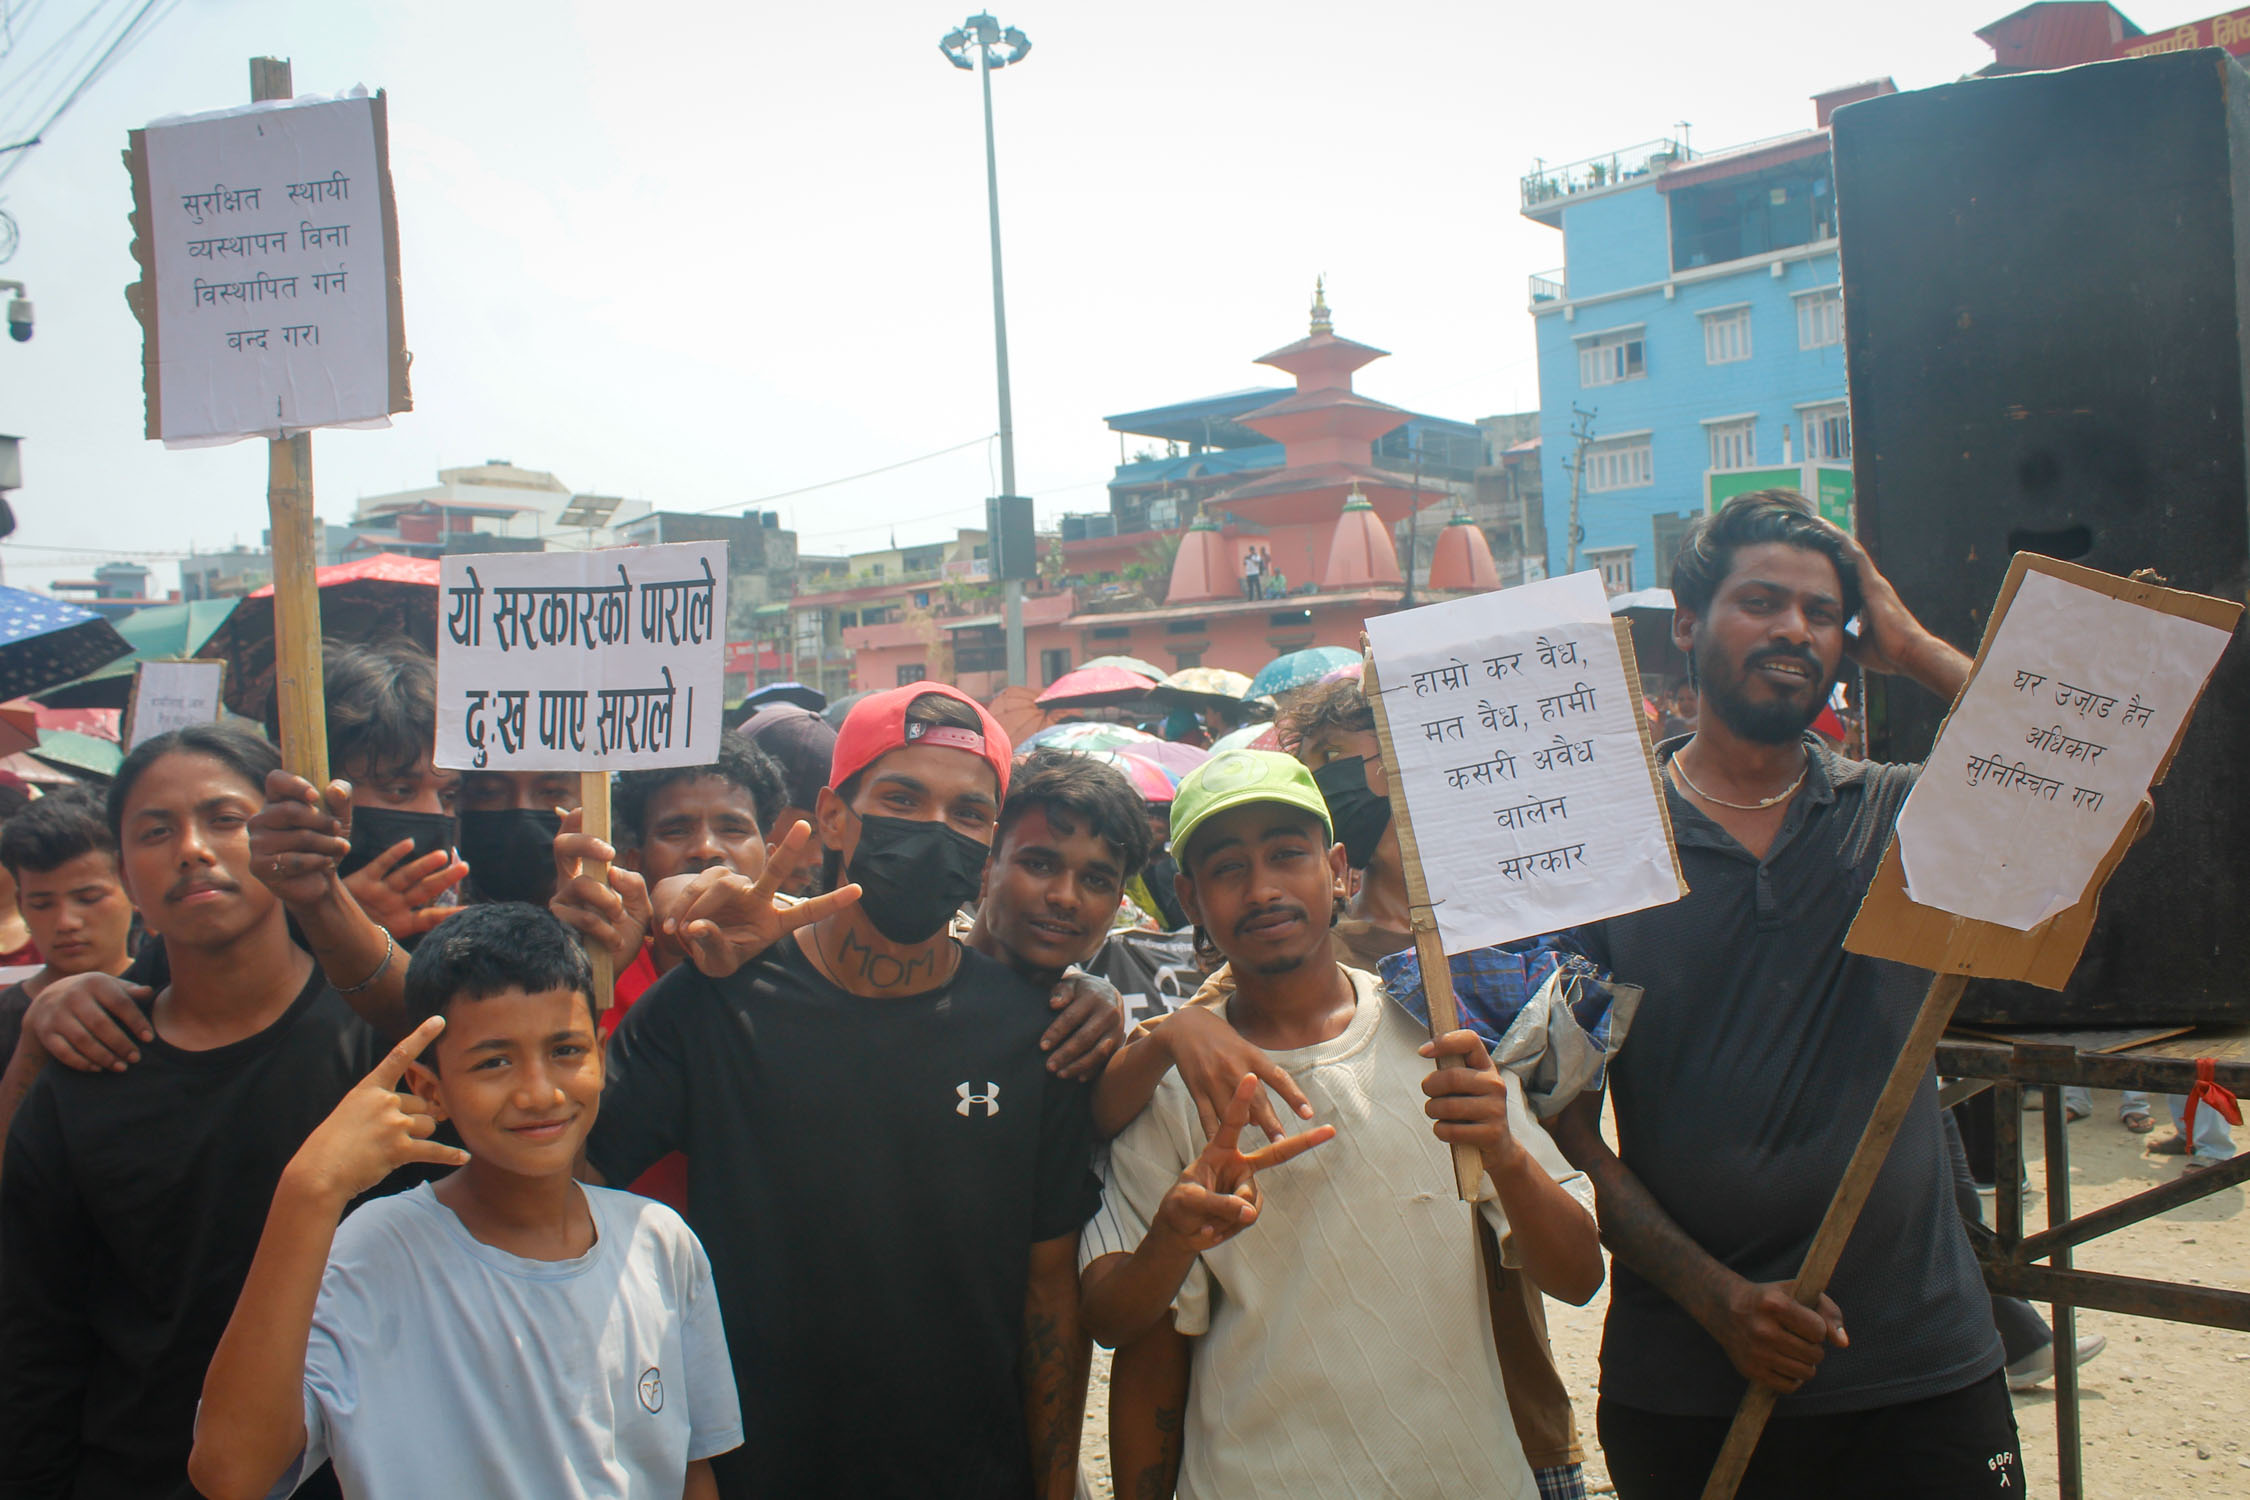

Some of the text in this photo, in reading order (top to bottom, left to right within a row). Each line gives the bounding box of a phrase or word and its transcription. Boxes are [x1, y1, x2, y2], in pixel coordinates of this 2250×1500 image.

[180, 170, 351, 225] सुरक्षित स्थायी
[299, 220, 351, 251] विना
[193, 262, 349, 308] विस्थापित गर्न
[447, 556, 717, 653] यो सरकारको पाराले
[1410, 636, 1587, 697] हाम्रो कर वैध,
[538, 690, 589, 753] पाए
[1420, 681, 1597, 743] मत वैध, हामी
[2013, 669, 2048, 697] घर
[2121, 693, 2155, 729] हैन
[1443, 734, 1594, 791] कसरी अवैध
[2025, 725, 2108, 767] अधिकार
[1493, 794, 1567, 830] बालेन
[1497, 843, 1586, 881] सरकार
[838, 927, 935, 988] MOM
